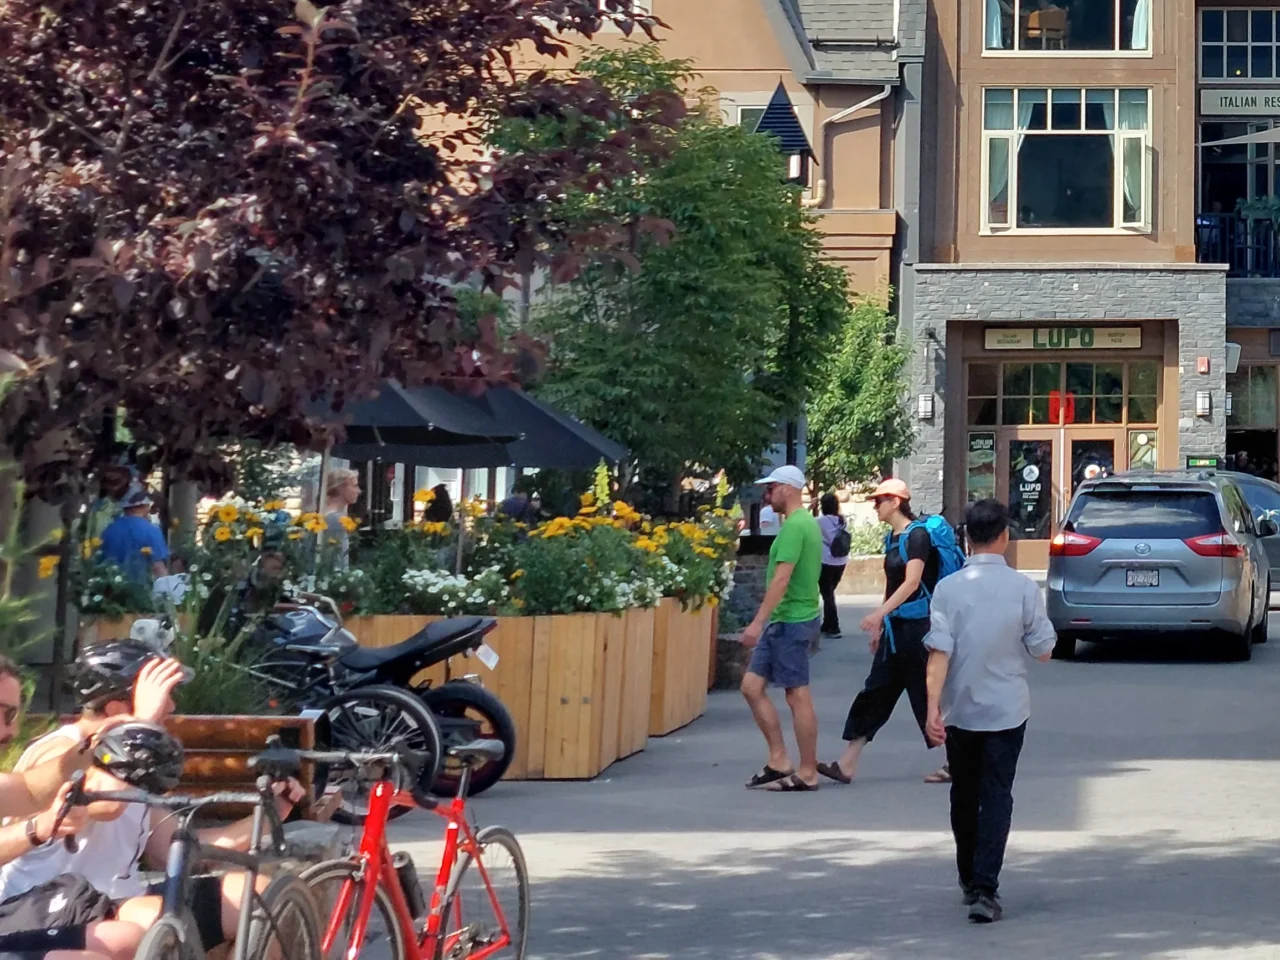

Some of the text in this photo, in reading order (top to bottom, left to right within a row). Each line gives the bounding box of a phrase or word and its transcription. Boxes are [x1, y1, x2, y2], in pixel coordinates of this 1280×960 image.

[1220, 96, 1257, 108] ITALIAN
[1033, 327, 1095, 348] LUPO
[1020, 483, 1041, 492] LUPO
